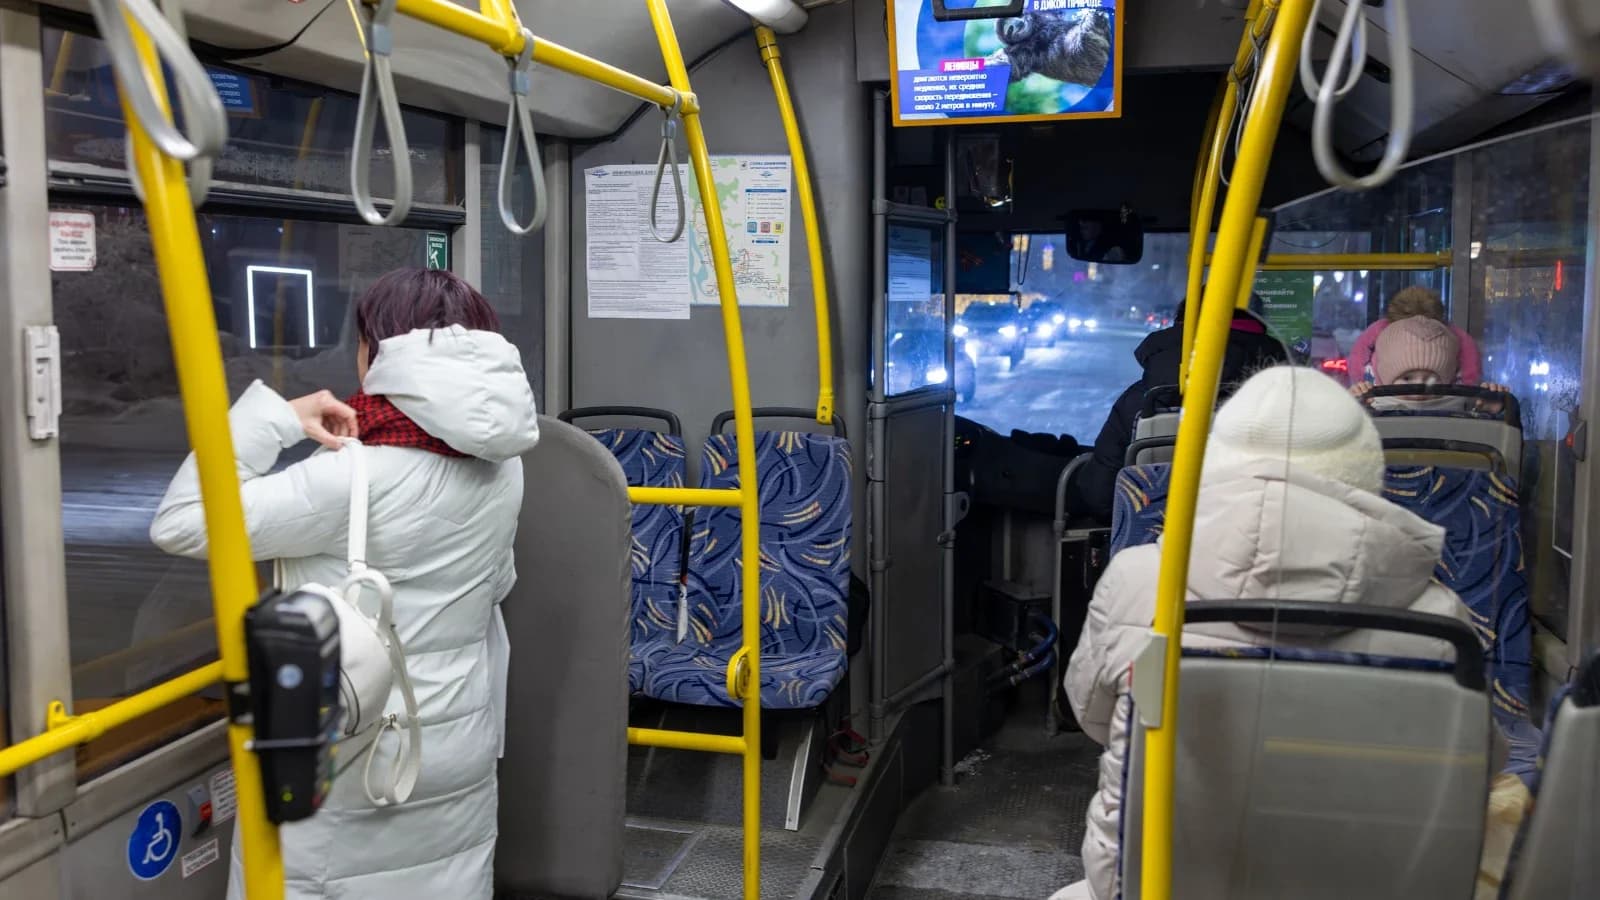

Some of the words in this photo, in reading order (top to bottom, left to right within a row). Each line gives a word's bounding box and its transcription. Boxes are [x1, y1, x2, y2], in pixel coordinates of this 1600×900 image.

[1033, 0, 1040, 10] В
[944, 60, 980, 72] ЛЕНИВЦЫ
[949, 74, 988, 82] невероятно
[914, 94, 943, 103] скорость
[941, 102, 965, 110] метров
